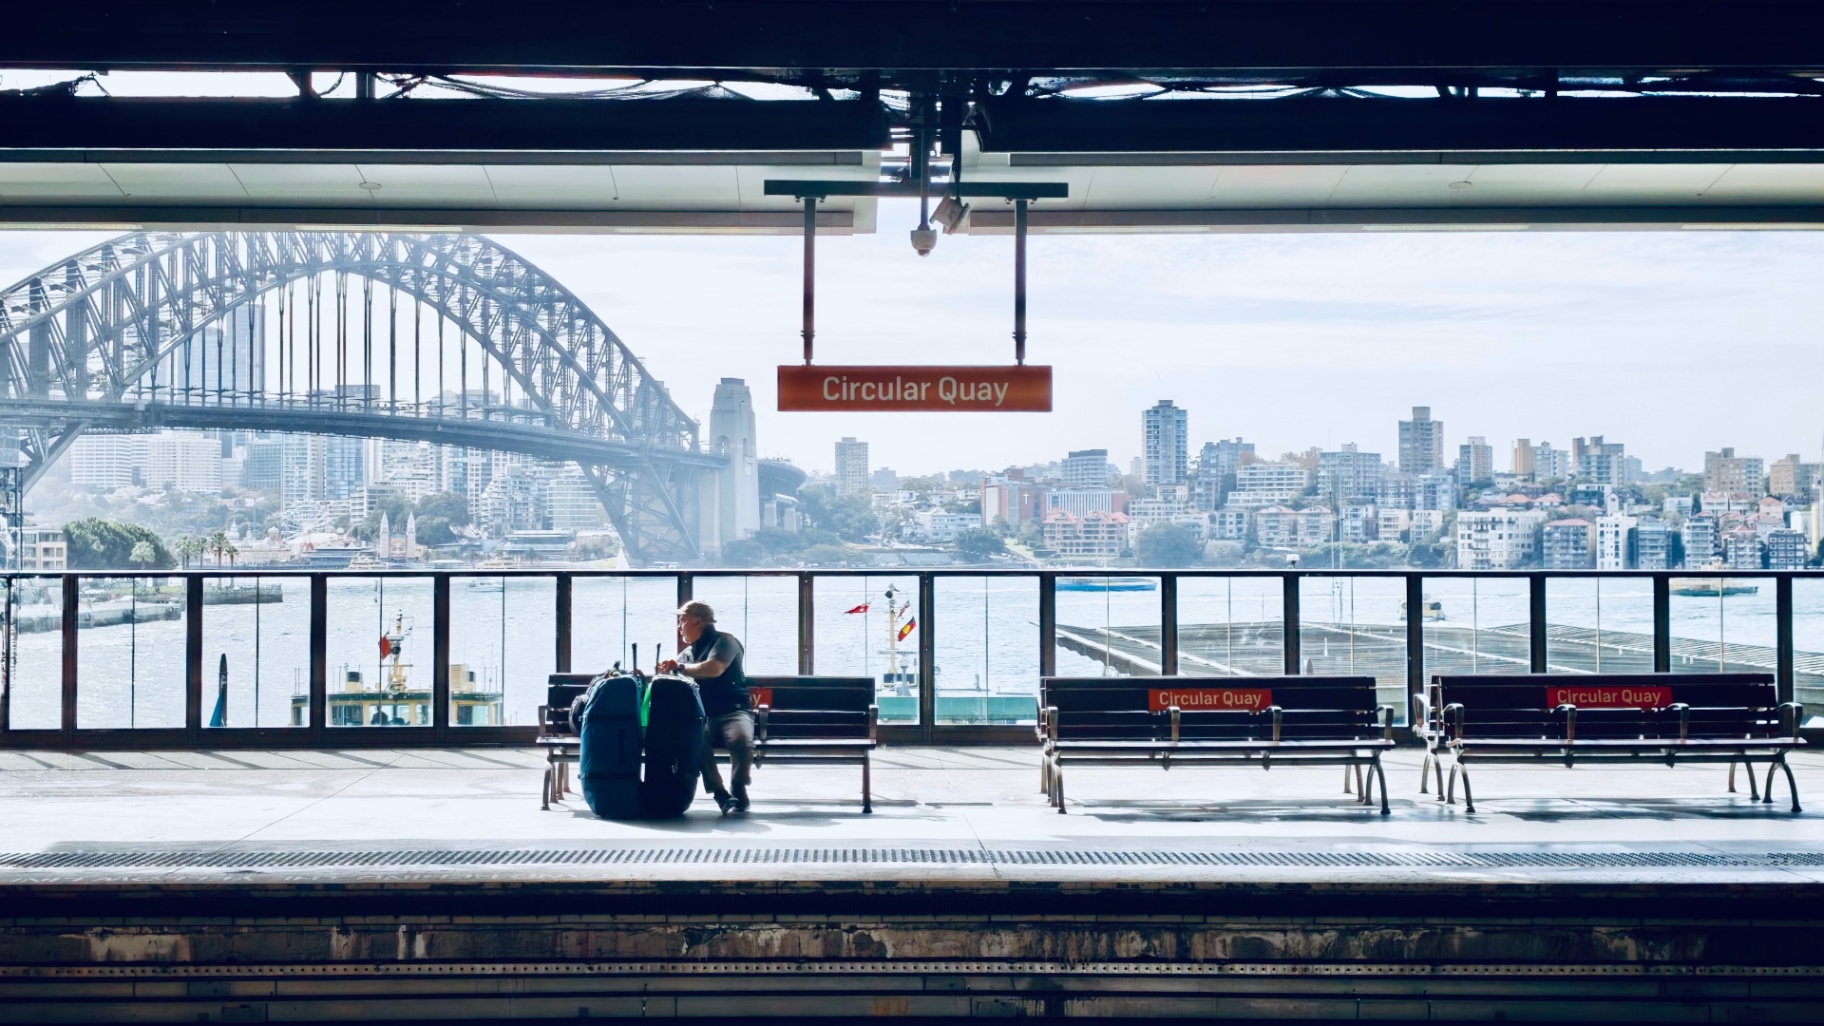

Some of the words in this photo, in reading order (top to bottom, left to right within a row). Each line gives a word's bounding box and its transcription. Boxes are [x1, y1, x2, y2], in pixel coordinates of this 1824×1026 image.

[823, 376, 931, 401] Circular
[938, 376, 1009, 407] Quay
[1160, 691, 1219, 705] Circular
[1223, 691, 1262, 707] Quay
[1557, 689, 1618, 703] Circular
[1621, 689, 1661, 705] Quay
